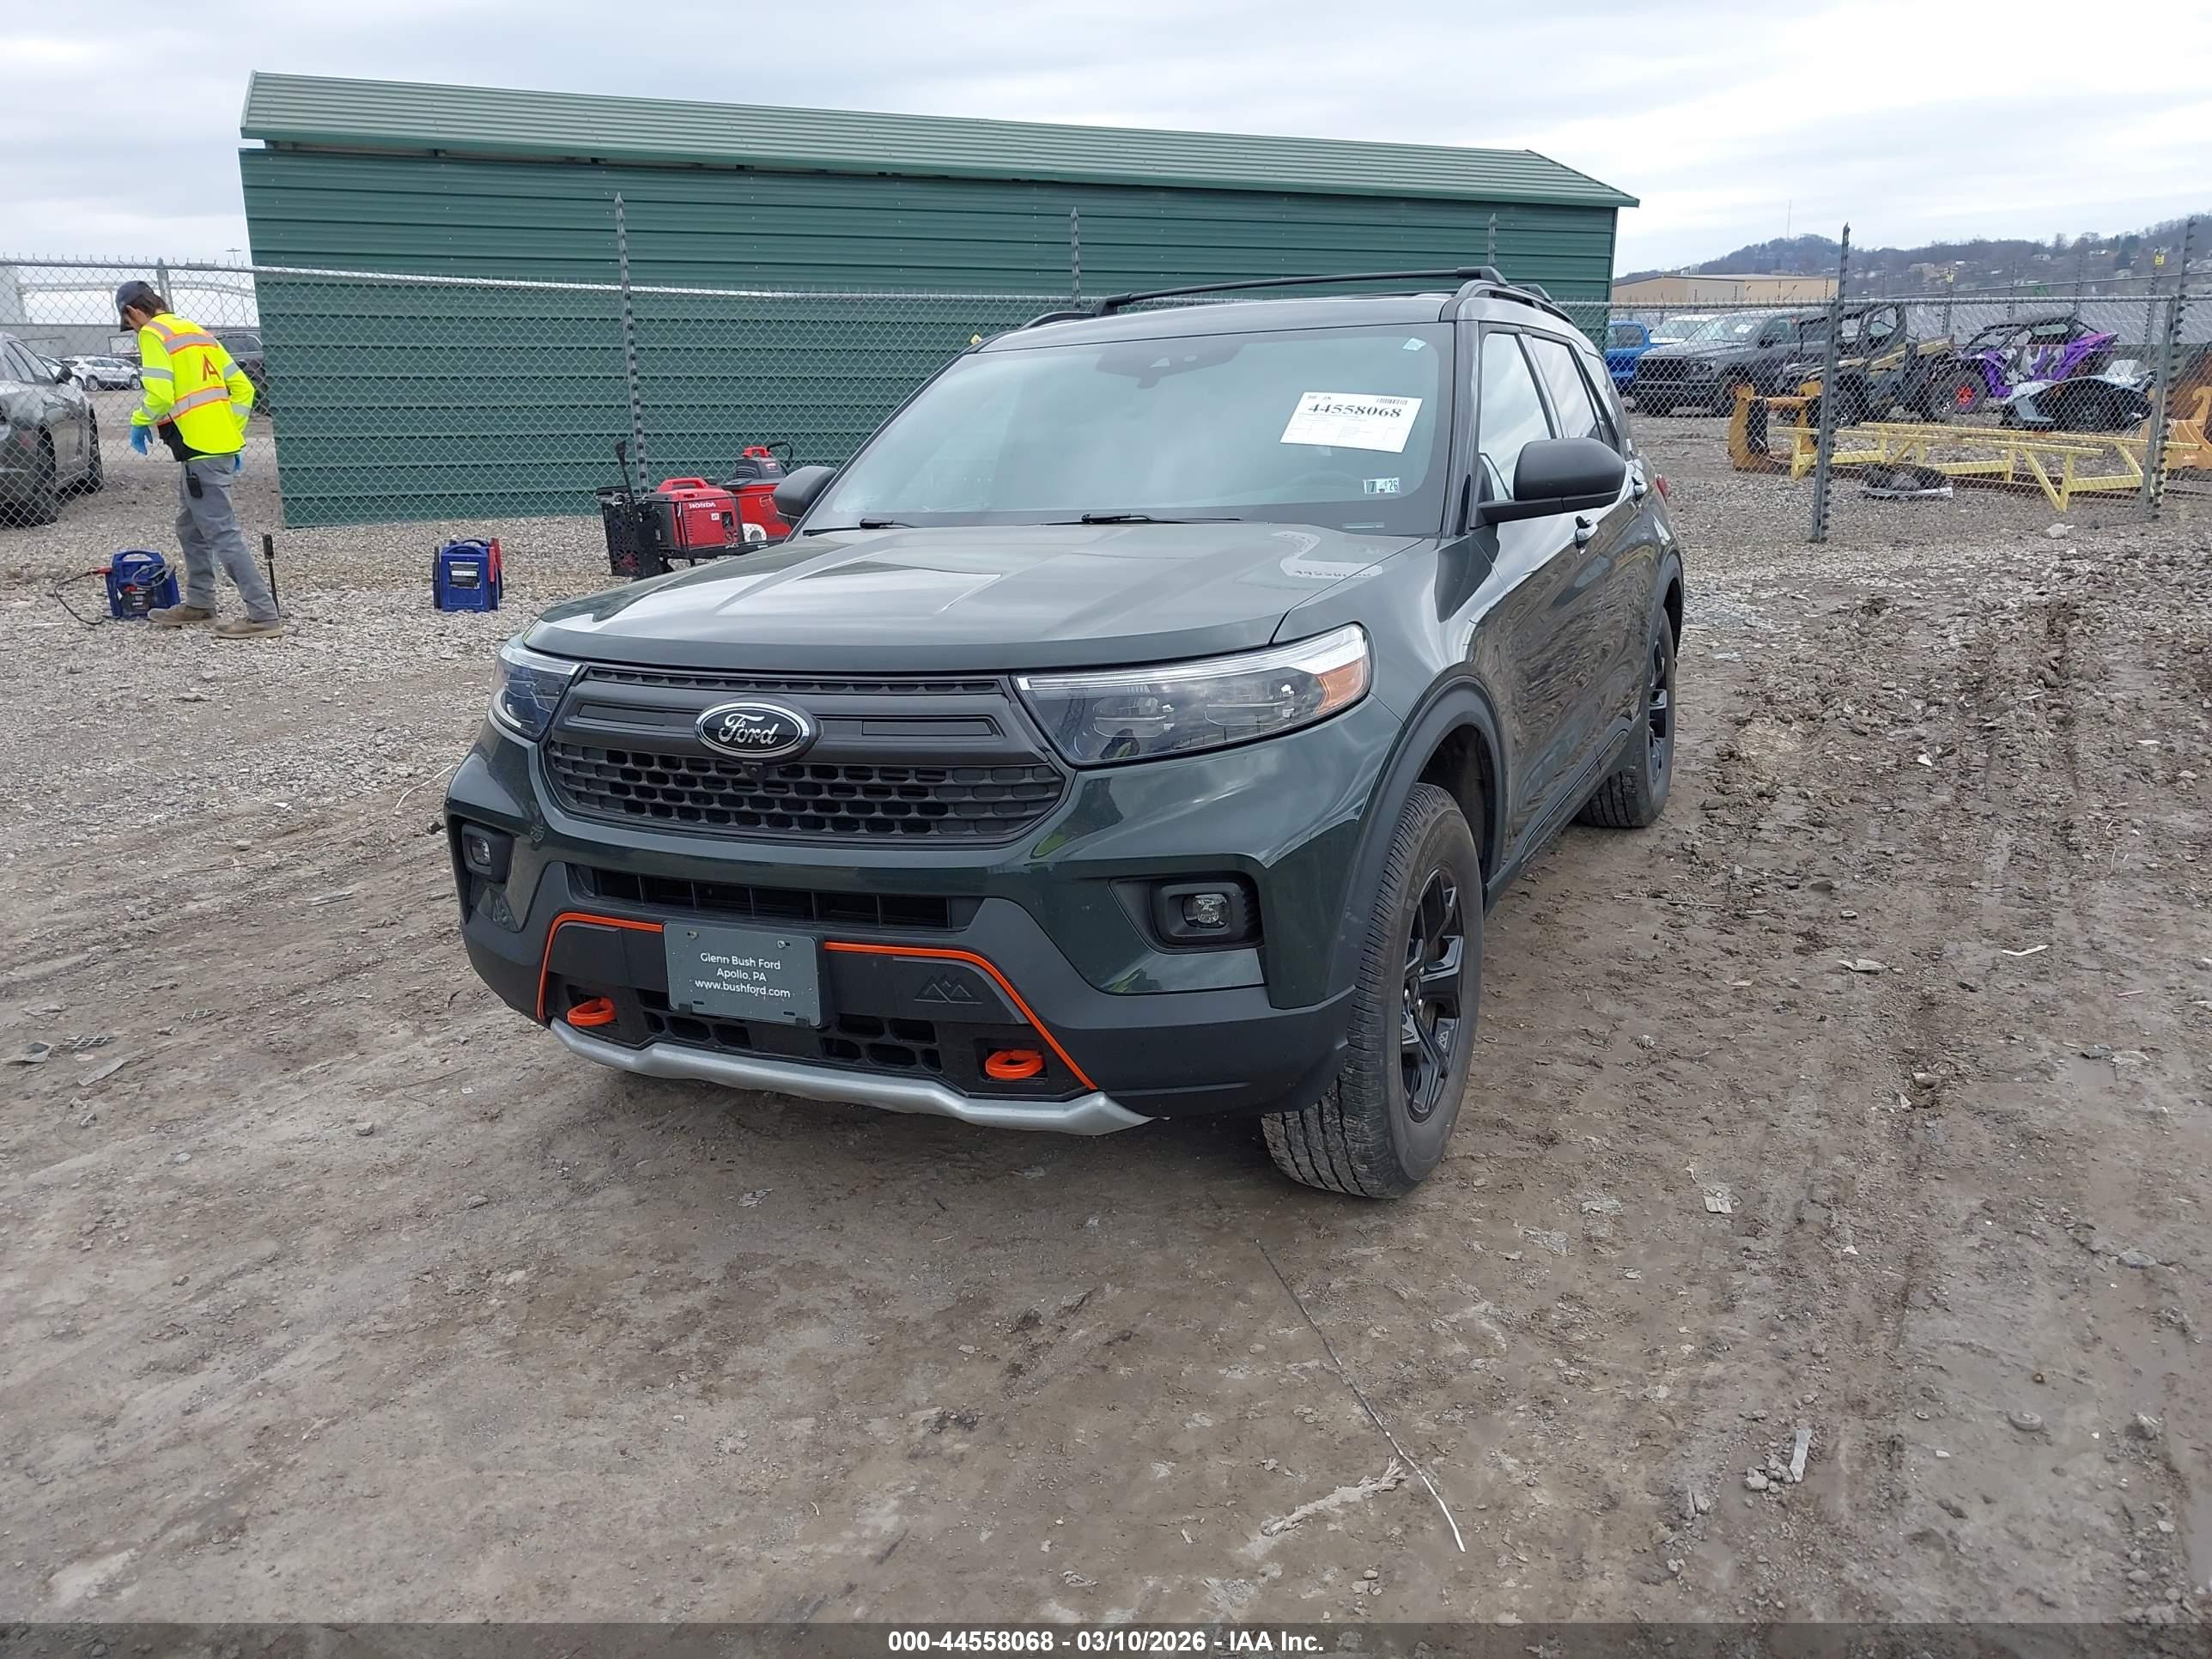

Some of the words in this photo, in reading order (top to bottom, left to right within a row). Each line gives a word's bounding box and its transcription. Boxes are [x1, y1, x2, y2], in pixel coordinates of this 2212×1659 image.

[1308, 403, 1402, 418] 44558068
[1389, 480, 1398, 491] 26
[718, 713, 780, 745] Ford
[700, 952, 730, 964] Glenn
[732, 956, 757, 967] Bush
[758, 958, 781, 969] Ford
[716, 968, 751, 981] Apollo,
[752, 971, 767, 981] PA
[695, 980, 791, 998] www.bushford.com
